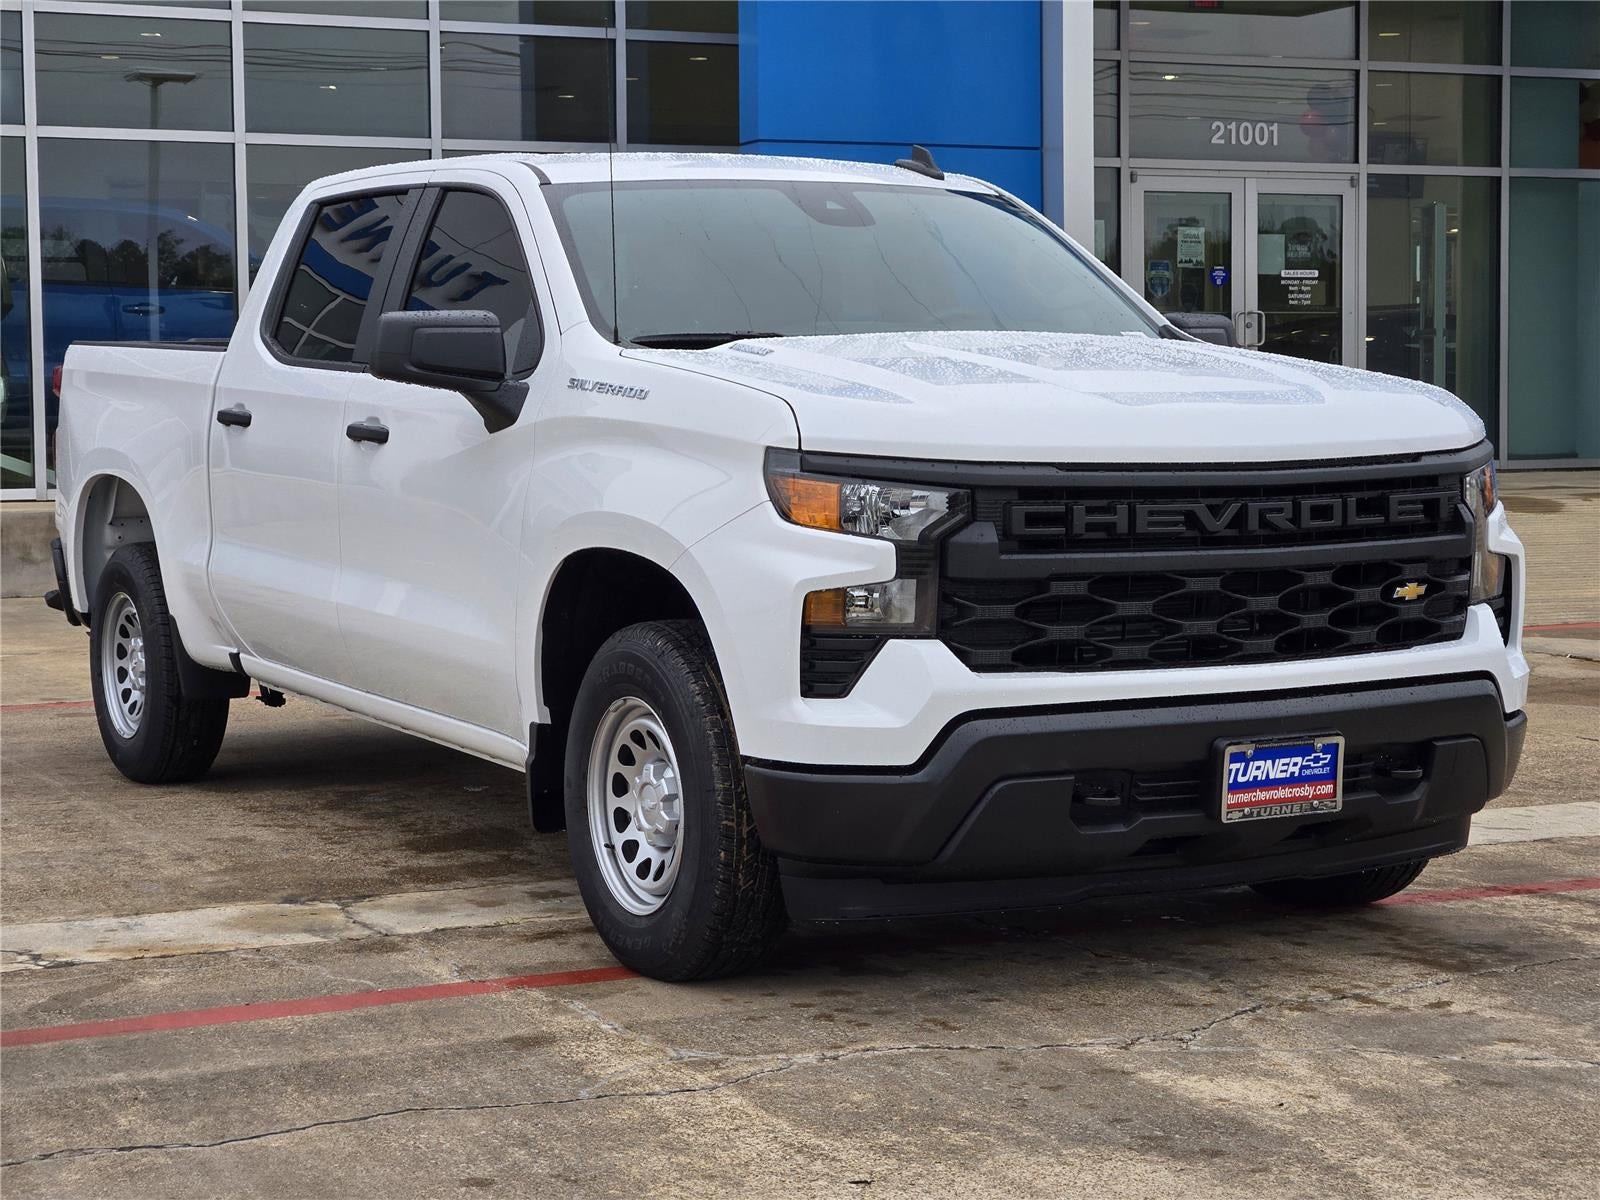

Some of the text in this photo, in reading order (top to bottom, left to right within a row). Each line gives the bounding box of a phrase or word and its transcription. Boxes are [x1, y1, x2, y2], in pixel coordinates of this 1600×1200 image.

[1210, 121, 1279, 146] 21001
[567, 377, 650, 401] SILVERADO
[1010, 490, 1460, 537] CHEVROLET
[1228, 757, 1303, 784] TURNER
[1301, 767, 1330, 776] CHEVROLET
[1227, 784, 1334, 805] turnerchevroletcrosby.com
[1251, 803, 1311, 817] TURNER
